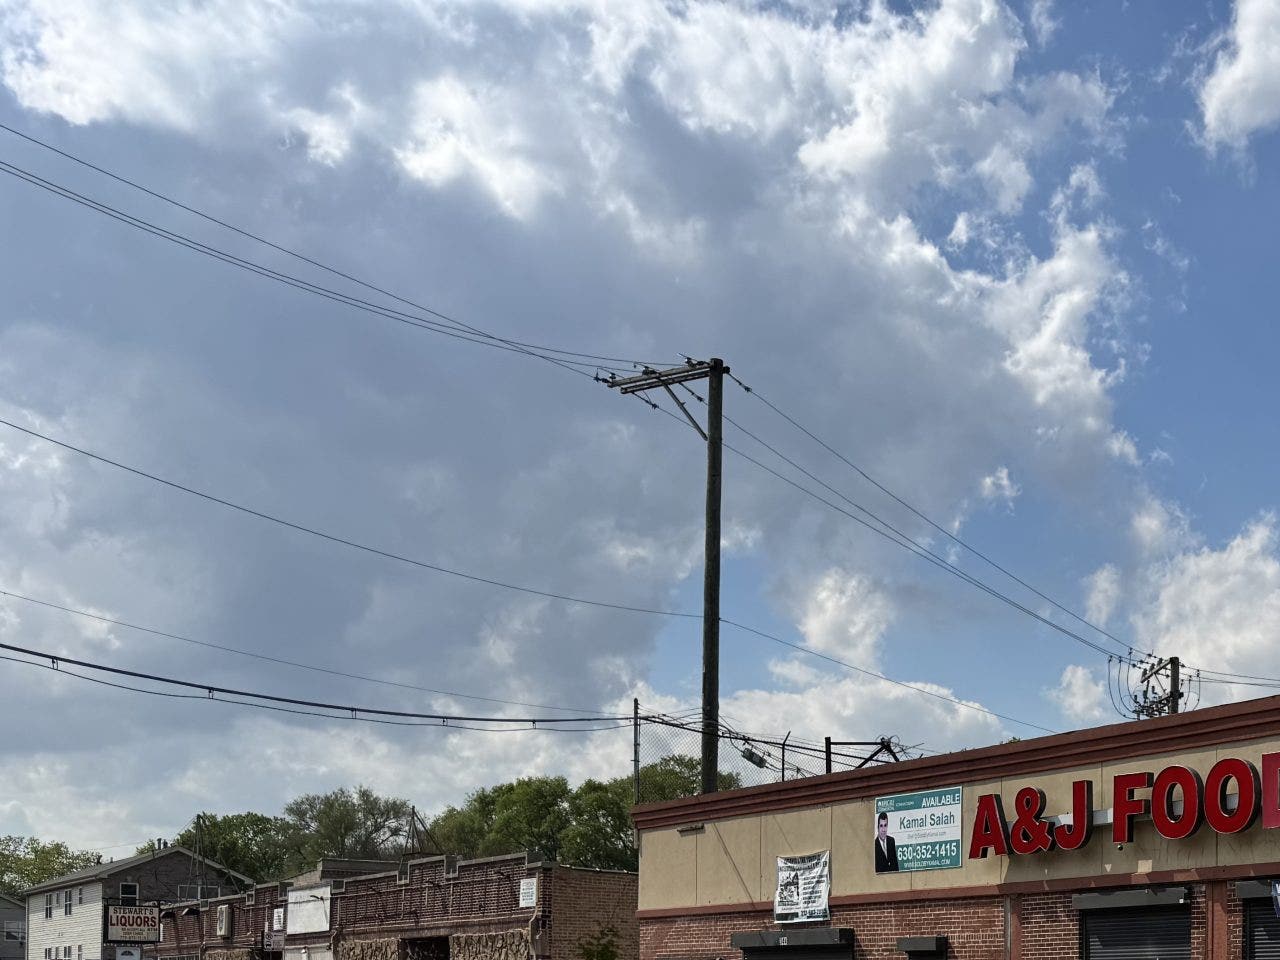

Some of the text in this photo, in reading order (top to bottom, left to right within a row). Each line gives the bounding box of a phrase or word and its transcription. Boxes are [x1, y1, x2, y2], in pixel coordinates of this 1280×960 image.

[921, 793, 961, 809] AVAILABLE
[899, 811, 956, 830] Kamal Salah
[969, 779, 1093, 860] A&J
[897, 842, 957, 861] 630-352-1415
[109, 914, 157, 928] LIQUORS
